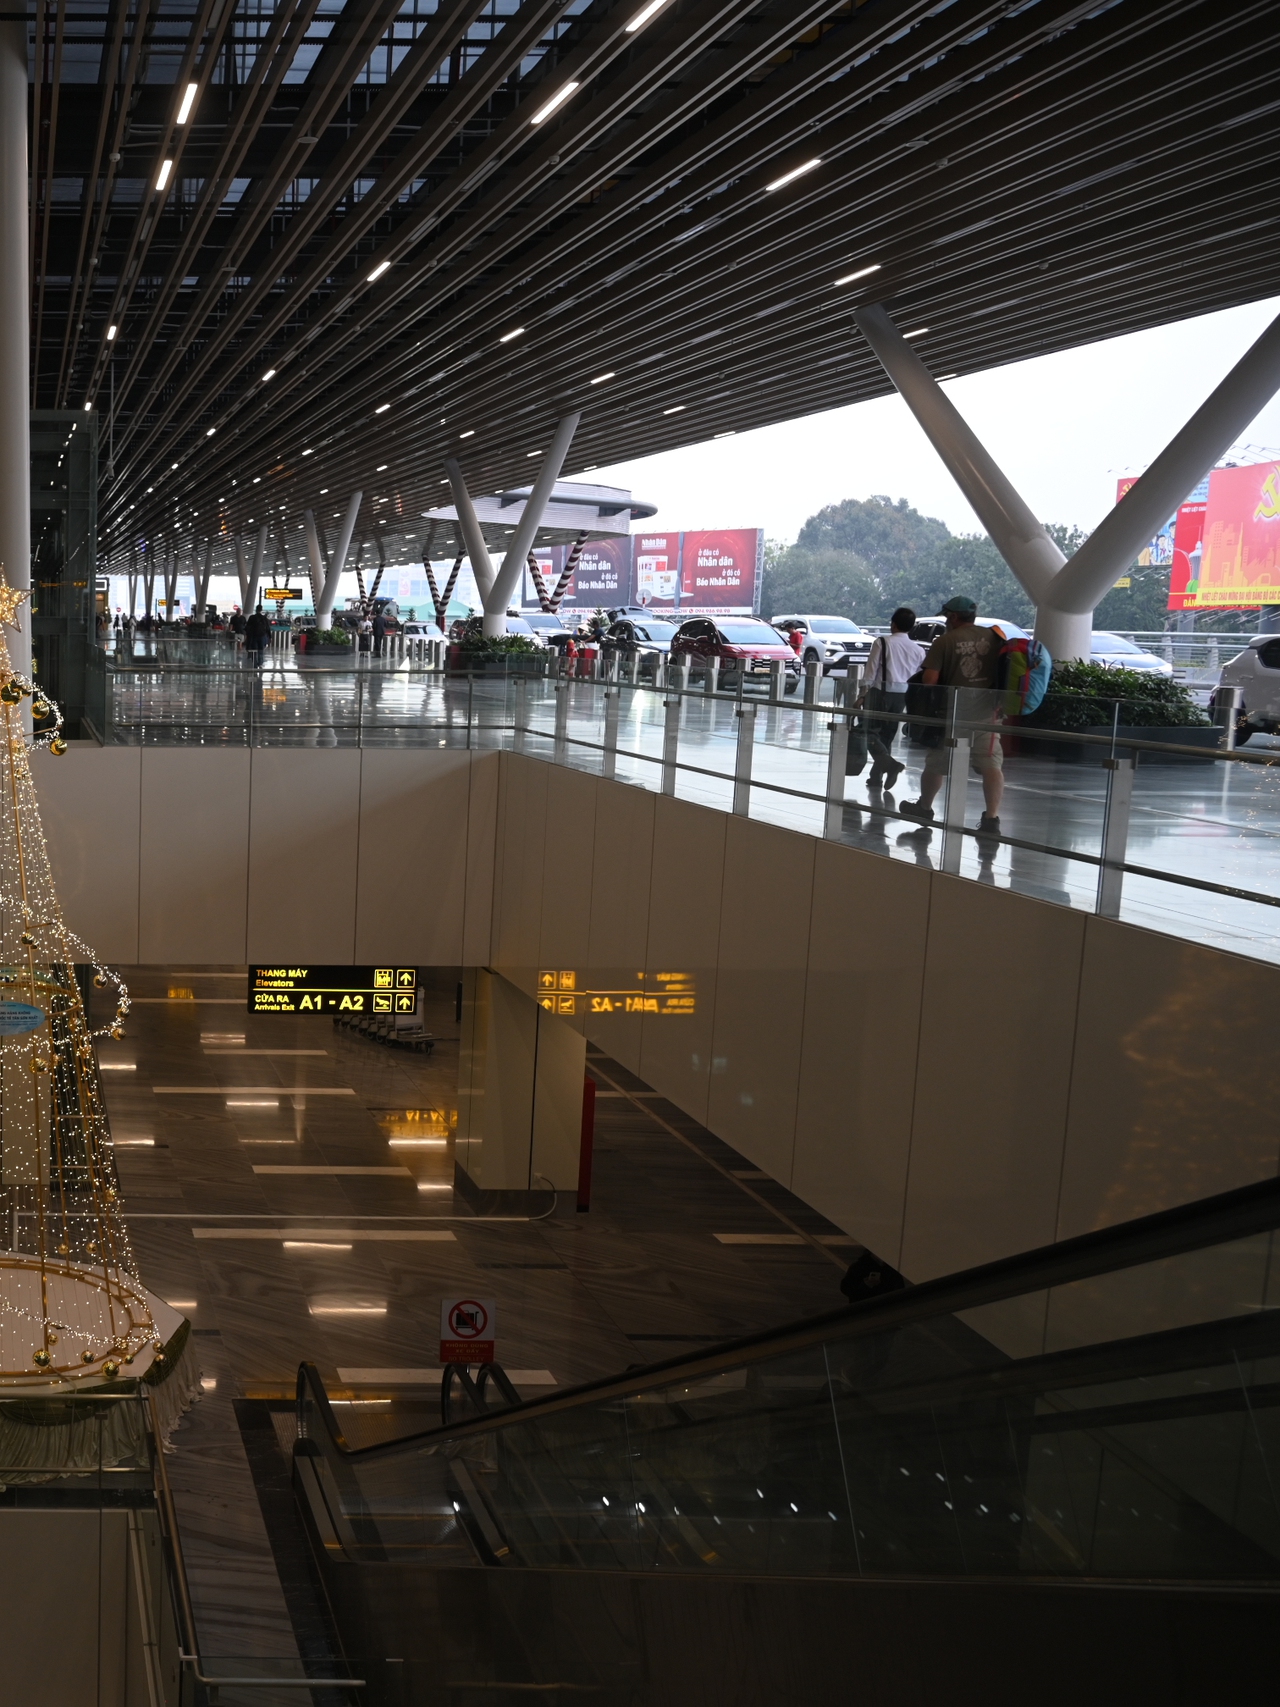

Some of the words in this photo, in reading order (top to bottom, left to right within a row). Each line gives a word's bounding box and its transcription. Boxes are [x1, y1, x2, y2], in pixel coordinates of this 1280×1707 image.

[579, 561, 597, 570] Nhân
[598, 560, 611, 570] dân
[698, 556, 718, 566] Nhân
[719, 556, 733, 566] dân
[578, 581, 589, 589] Báo
[696, 578, 708, 586] Báo
[710, 577, 726, 586] Nhân
[727, 577, 740, 586] Dân
[256, 969, 286, 978] THANG
[288, 968, 308, 978] MÁY
[256, 979, 294, 988] Elevators
[255, 994, 275, 1003] CỬA
[276, 995, 290, 1003] RA
[299, 995, 322, 1010] A1
[339, 995, 364, 1010] A2
